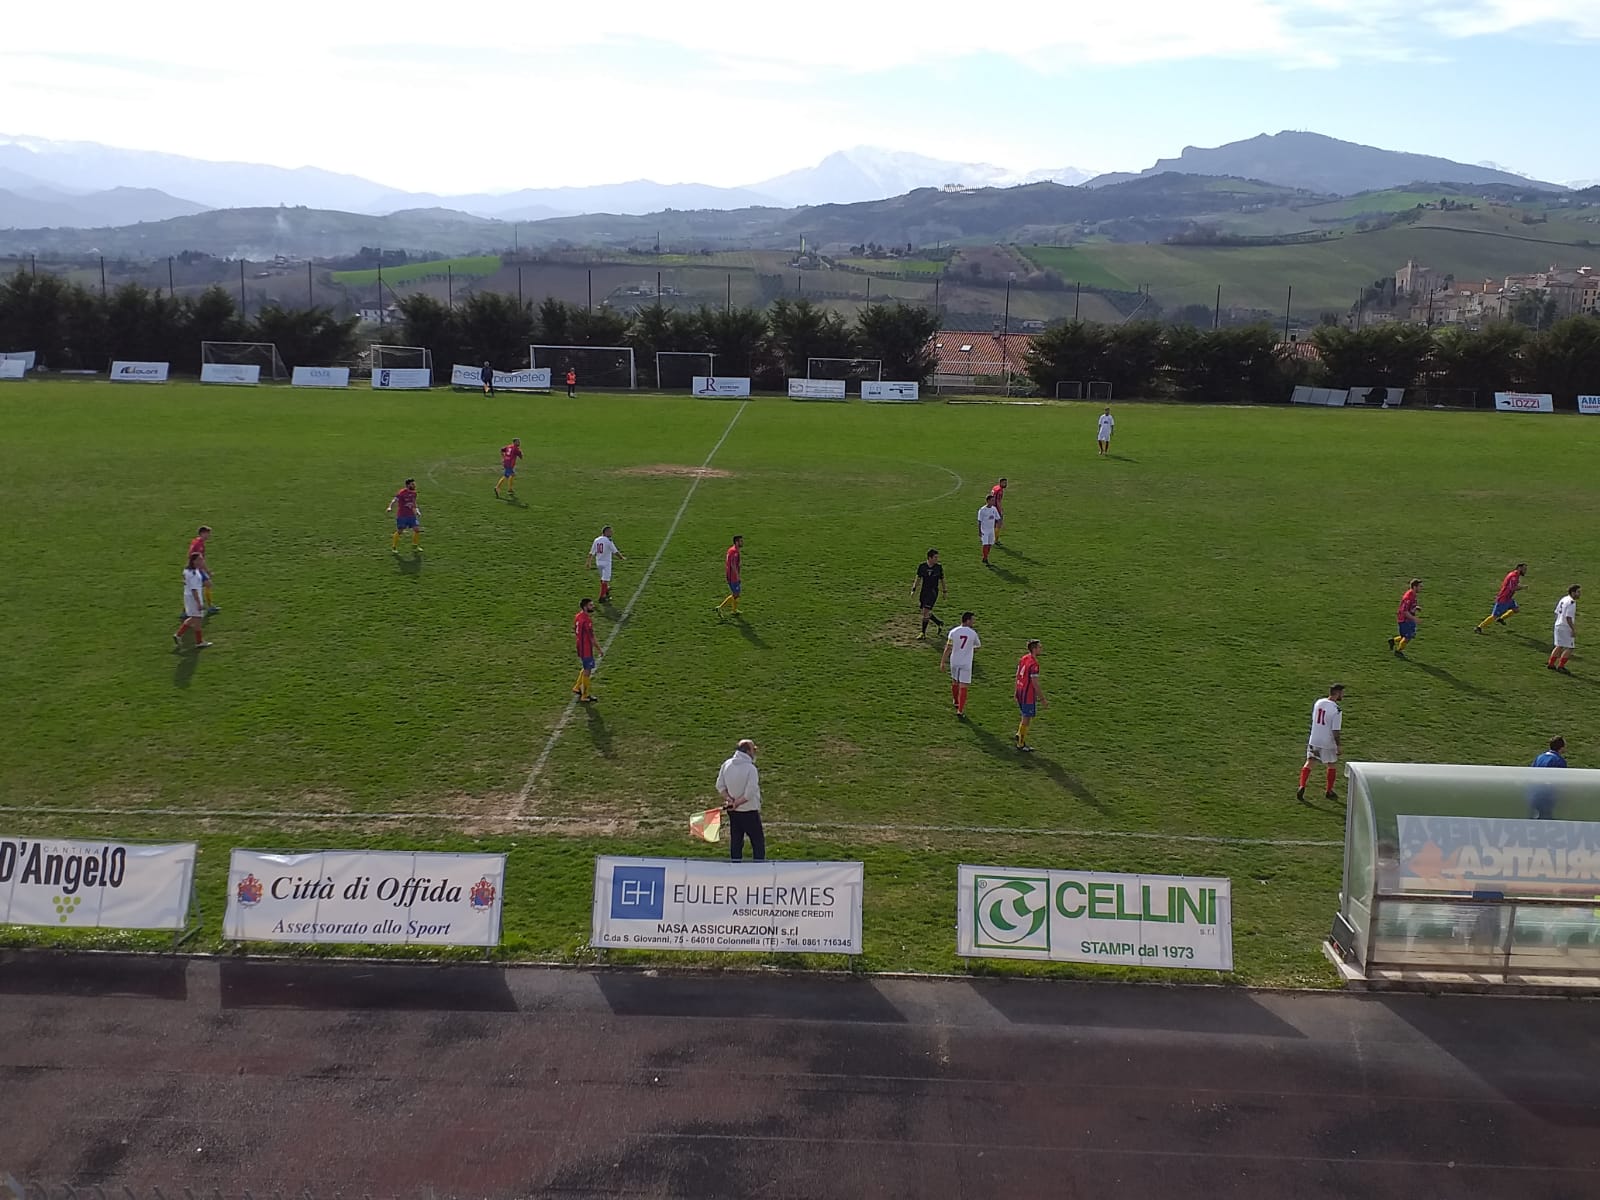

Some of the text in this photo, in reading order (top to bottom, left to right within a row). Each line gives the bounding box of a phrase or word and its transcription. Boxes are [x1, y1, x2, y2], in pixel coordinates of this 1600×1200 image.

[494, 373, 546, 384] prometeo
[960, 635, 968, 649] 7
[1317, 708, 1326, 726] 11
[43, 846, 99, 855] CANTINA
[271, 876, 462, 908] Città di Offida
[673, 884, 835, 907] EULER HERMES
[1056, 880, 1217, 925] CELLINI
[732, 908, 834, 918] ASSICURAZIONE CREDITI
[272, 919, 452, 938] Assessorato allo Sport
[657, 923, 689, 935] NASA
[692, 924, 778, 936] ASSICURAZIONI
[603, 934, 621, 942] C.da
[762, 937, 779, 947] (TE)
[1081, 941, 1194, 959] STAMPI dal 1973
